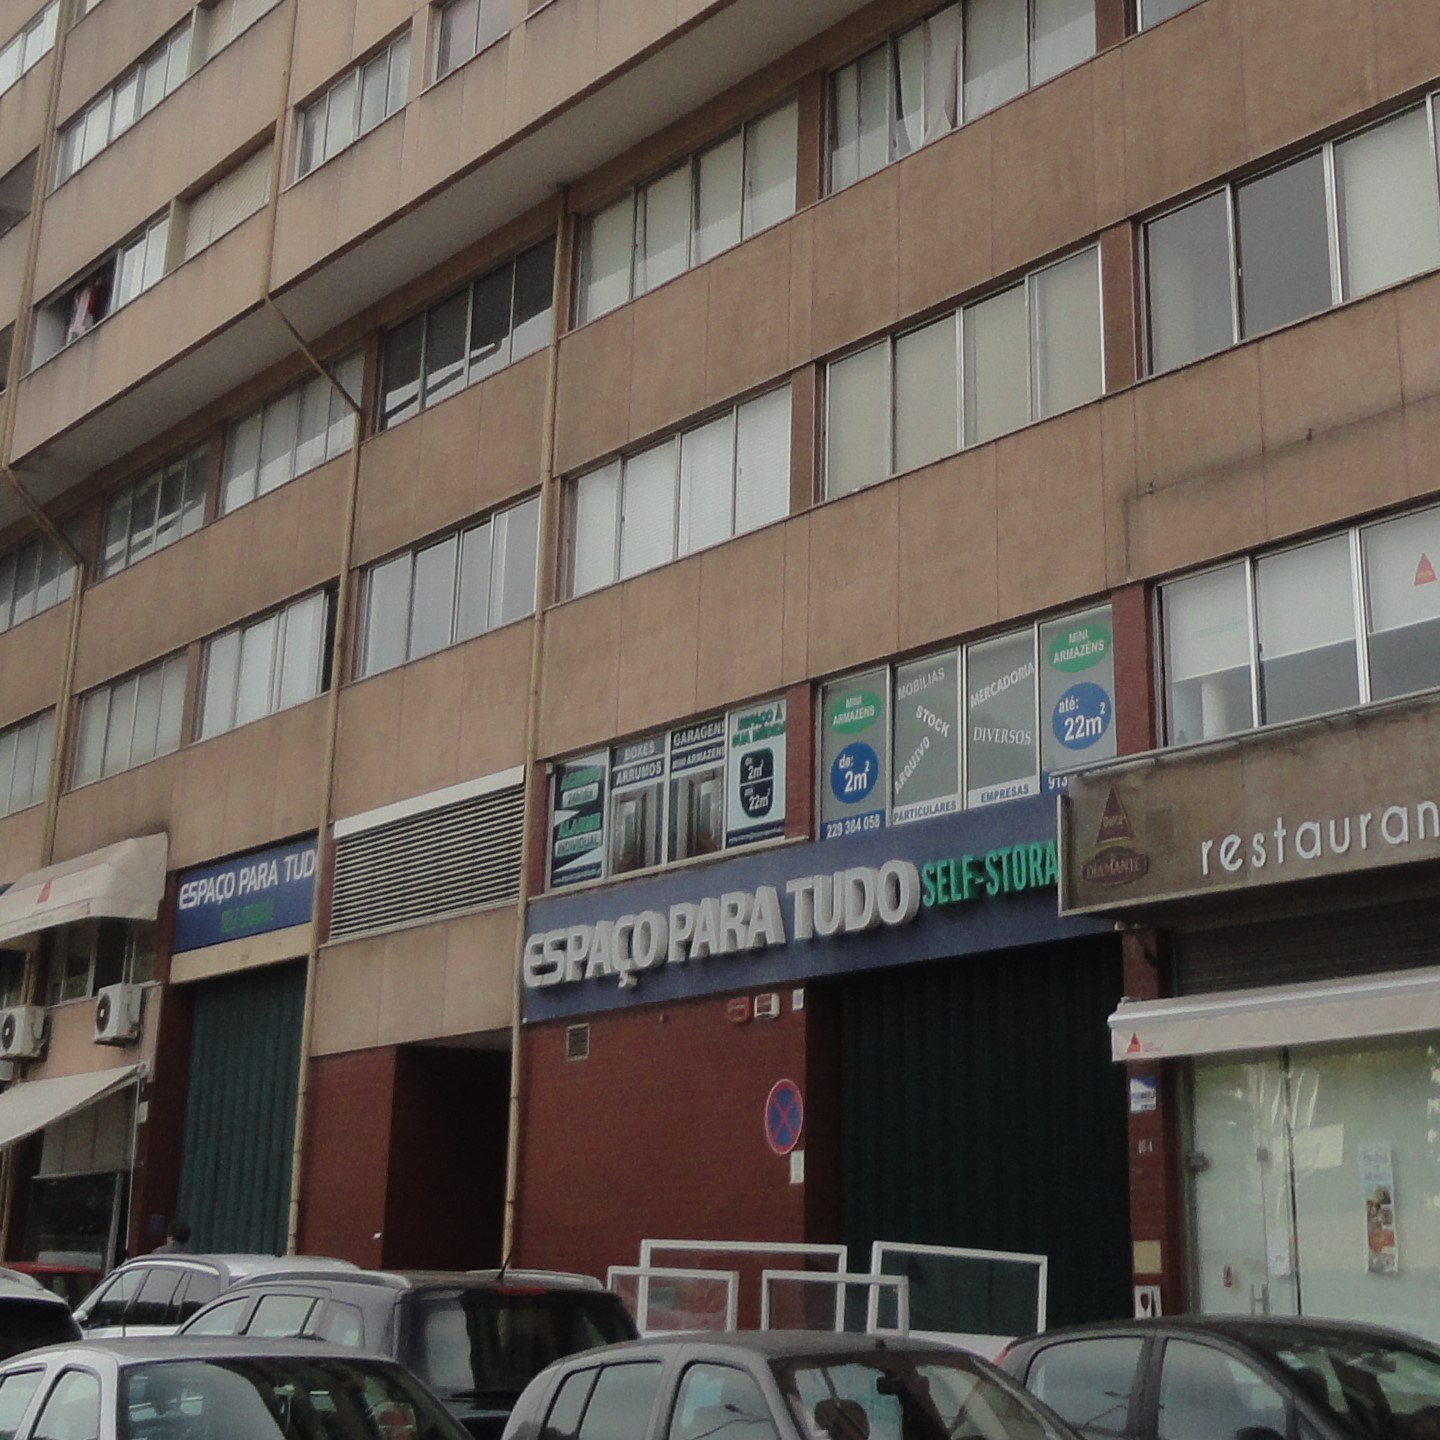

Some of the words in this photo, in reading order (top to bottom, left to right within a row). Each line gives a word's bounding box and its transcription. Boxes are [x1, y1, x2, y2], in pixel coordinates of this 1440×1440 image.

[1069, 629, 1088, 645] MINI
[970, 661, 1036, 709] MERCADORIA
[1058, 695, 1079, 714] até:
[915, 704, 951, 738] STOCK
[973, 726, 1032, 746] DIVERSOS
[624, 741, 656, 762] BOXES
[615, 760, 662, 786] ARRUMOS
[893, 736, 931, 795] ARQUIVO
[980, 783, 1029, 804] EMPRESAS
[893, 799, 957, 823] PARTICULARES
[826, 823, 843, 840] 229
[863, 813, 881, 831] 058
[178, 870, 236, 910] ESPAÇO
[237, 859, 279, 896] PARA
[523, 910, 667, 989] ESPAÇO
[668, 885, 787, 963] PARA
[785, 859, 921, 941] TUDO
[921, 839, 1058, 909] SELF-STORA
